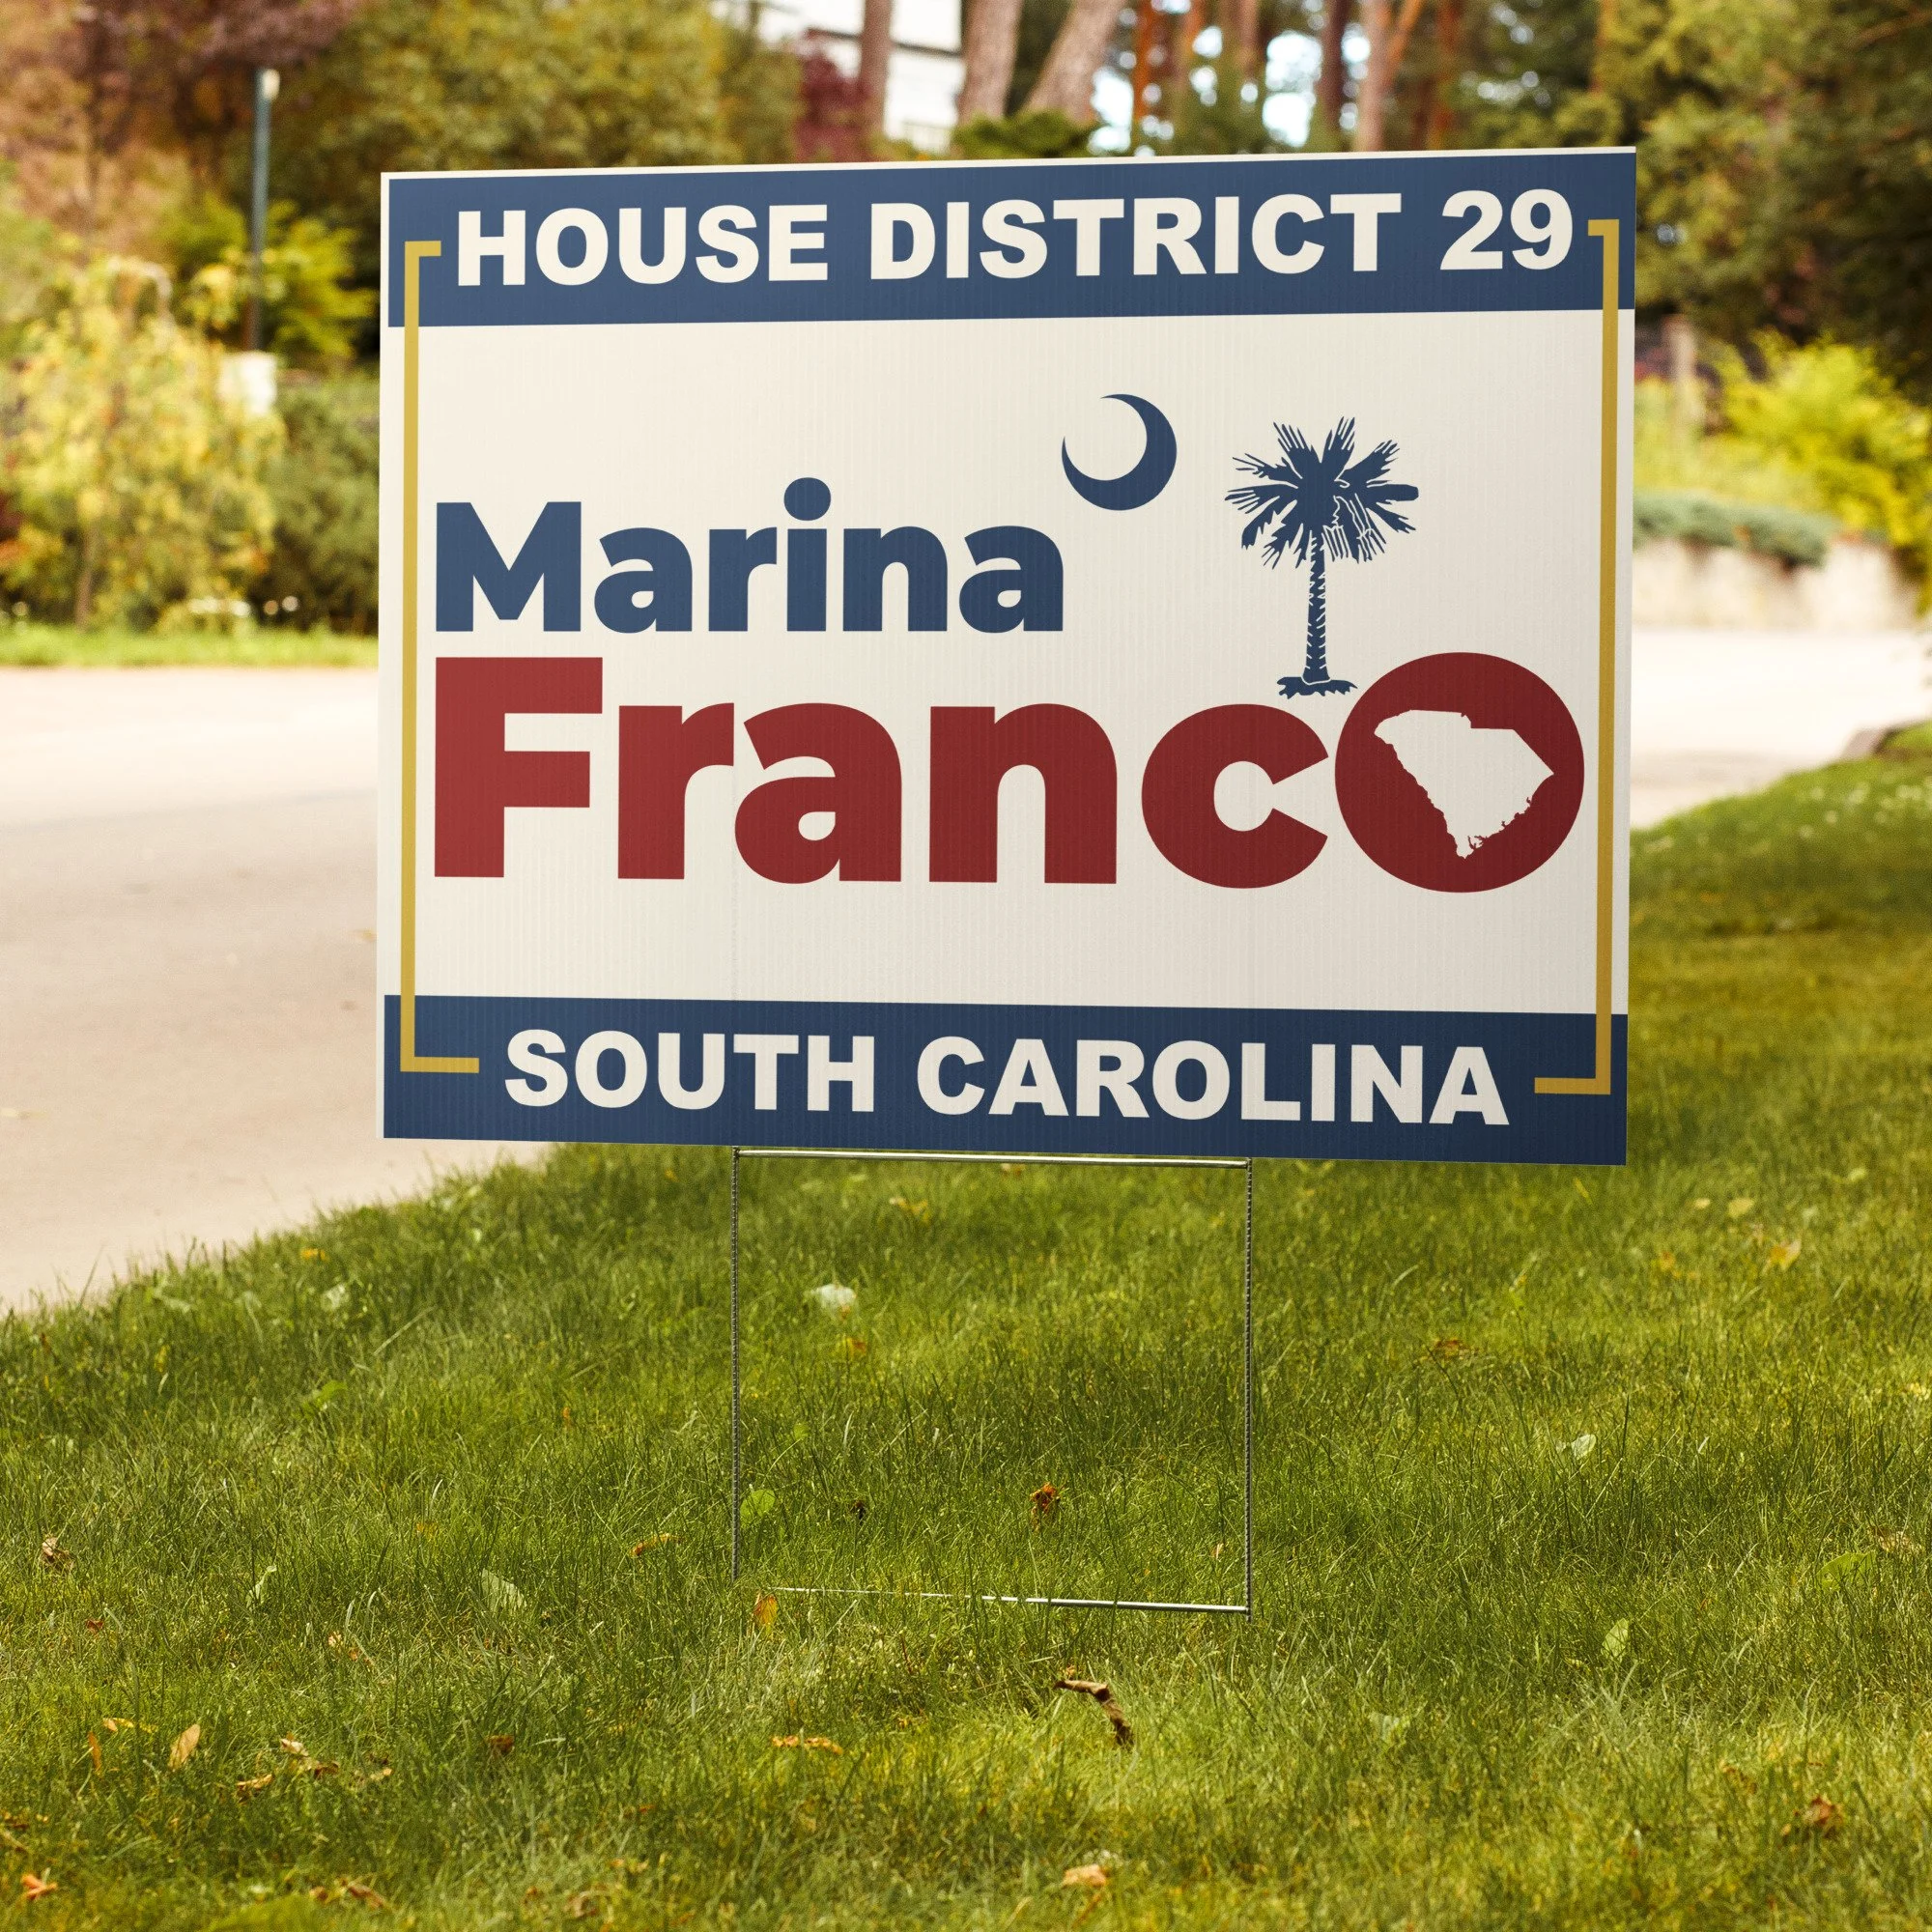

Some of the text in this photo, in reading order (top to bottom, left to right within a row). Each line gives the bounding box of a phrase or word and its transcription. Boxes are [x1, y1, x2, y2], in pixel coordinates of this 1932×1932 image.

[458, 188, 1573, 287] HOUSE DISTRICT 29
[436, 476, 1064, 634] Marina
[435, 652, 1584, 893] Franco
[504, 1029, 1510, 1125] SOUTH CAROLINA
